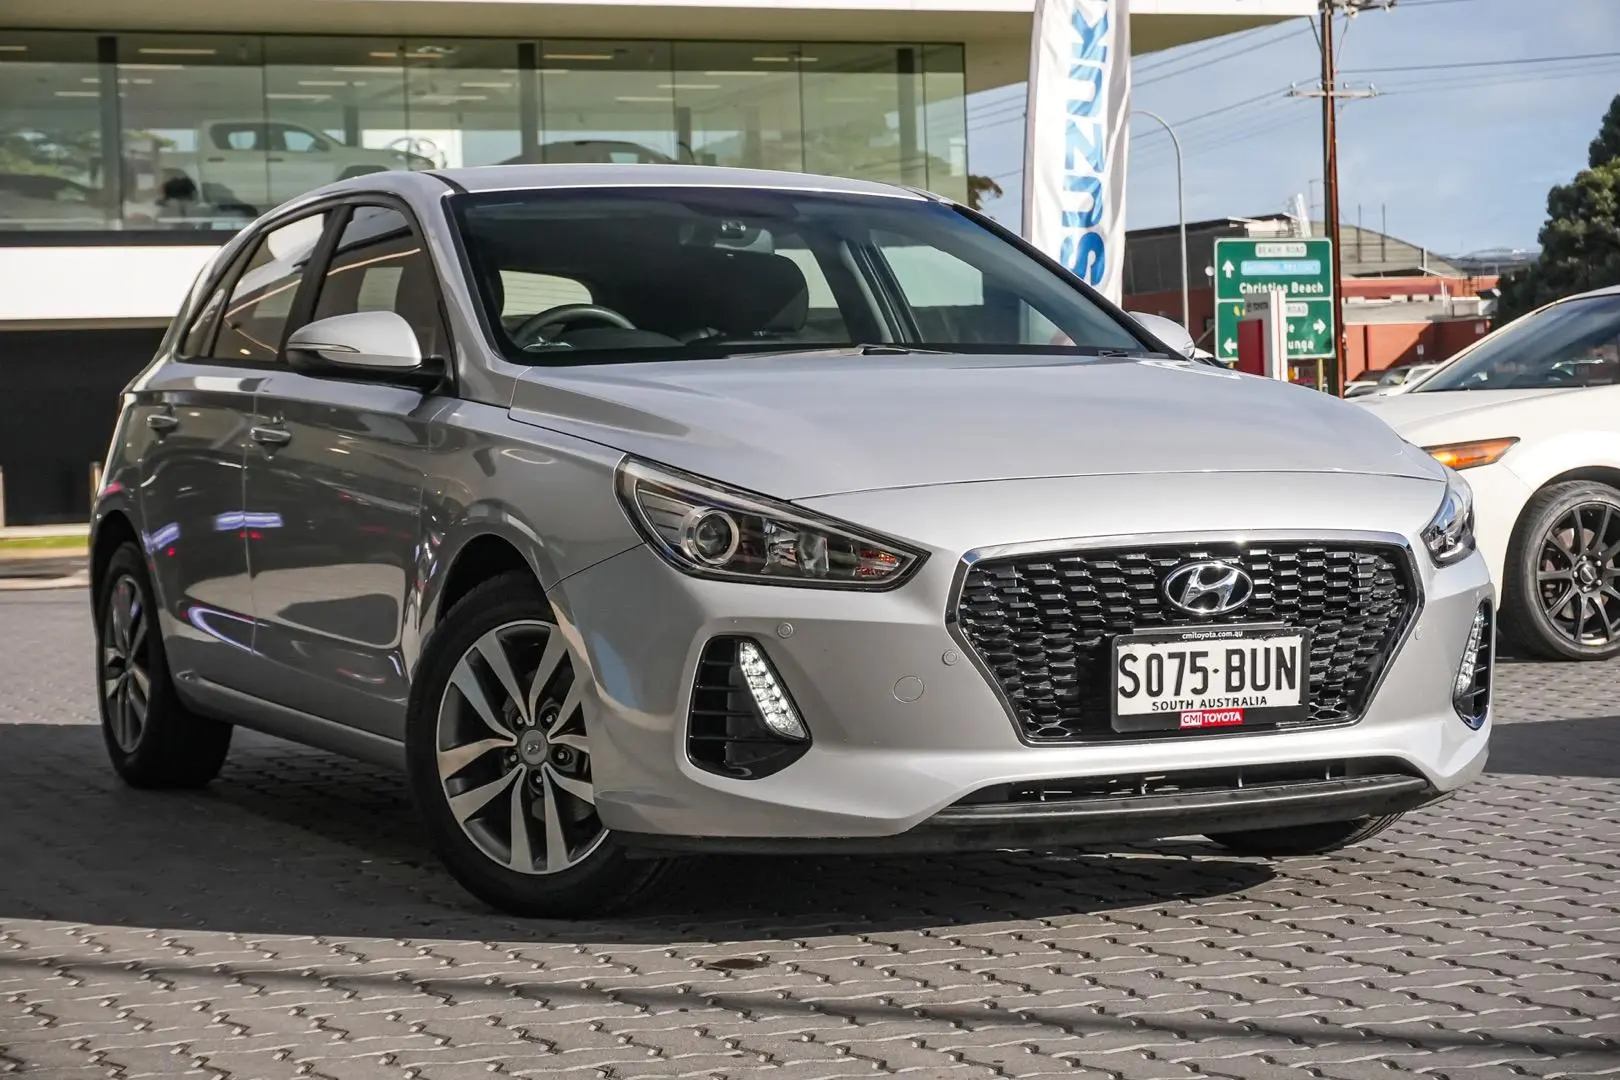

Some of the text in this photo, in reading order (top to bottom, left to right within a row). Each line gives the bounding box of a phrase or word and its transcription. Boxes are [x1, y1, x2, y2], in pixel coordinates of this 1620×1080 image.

[1060, 5, 1108, 286] SUZUK
[1239, 281, 1324, 294] Christies Beach
[1288, 340, 1314, 352] unga
[1152, 695, 1268, 711] SOUTH AUSTRALIA
[1182, 711, 1242, 724] CMI TOYOTA
